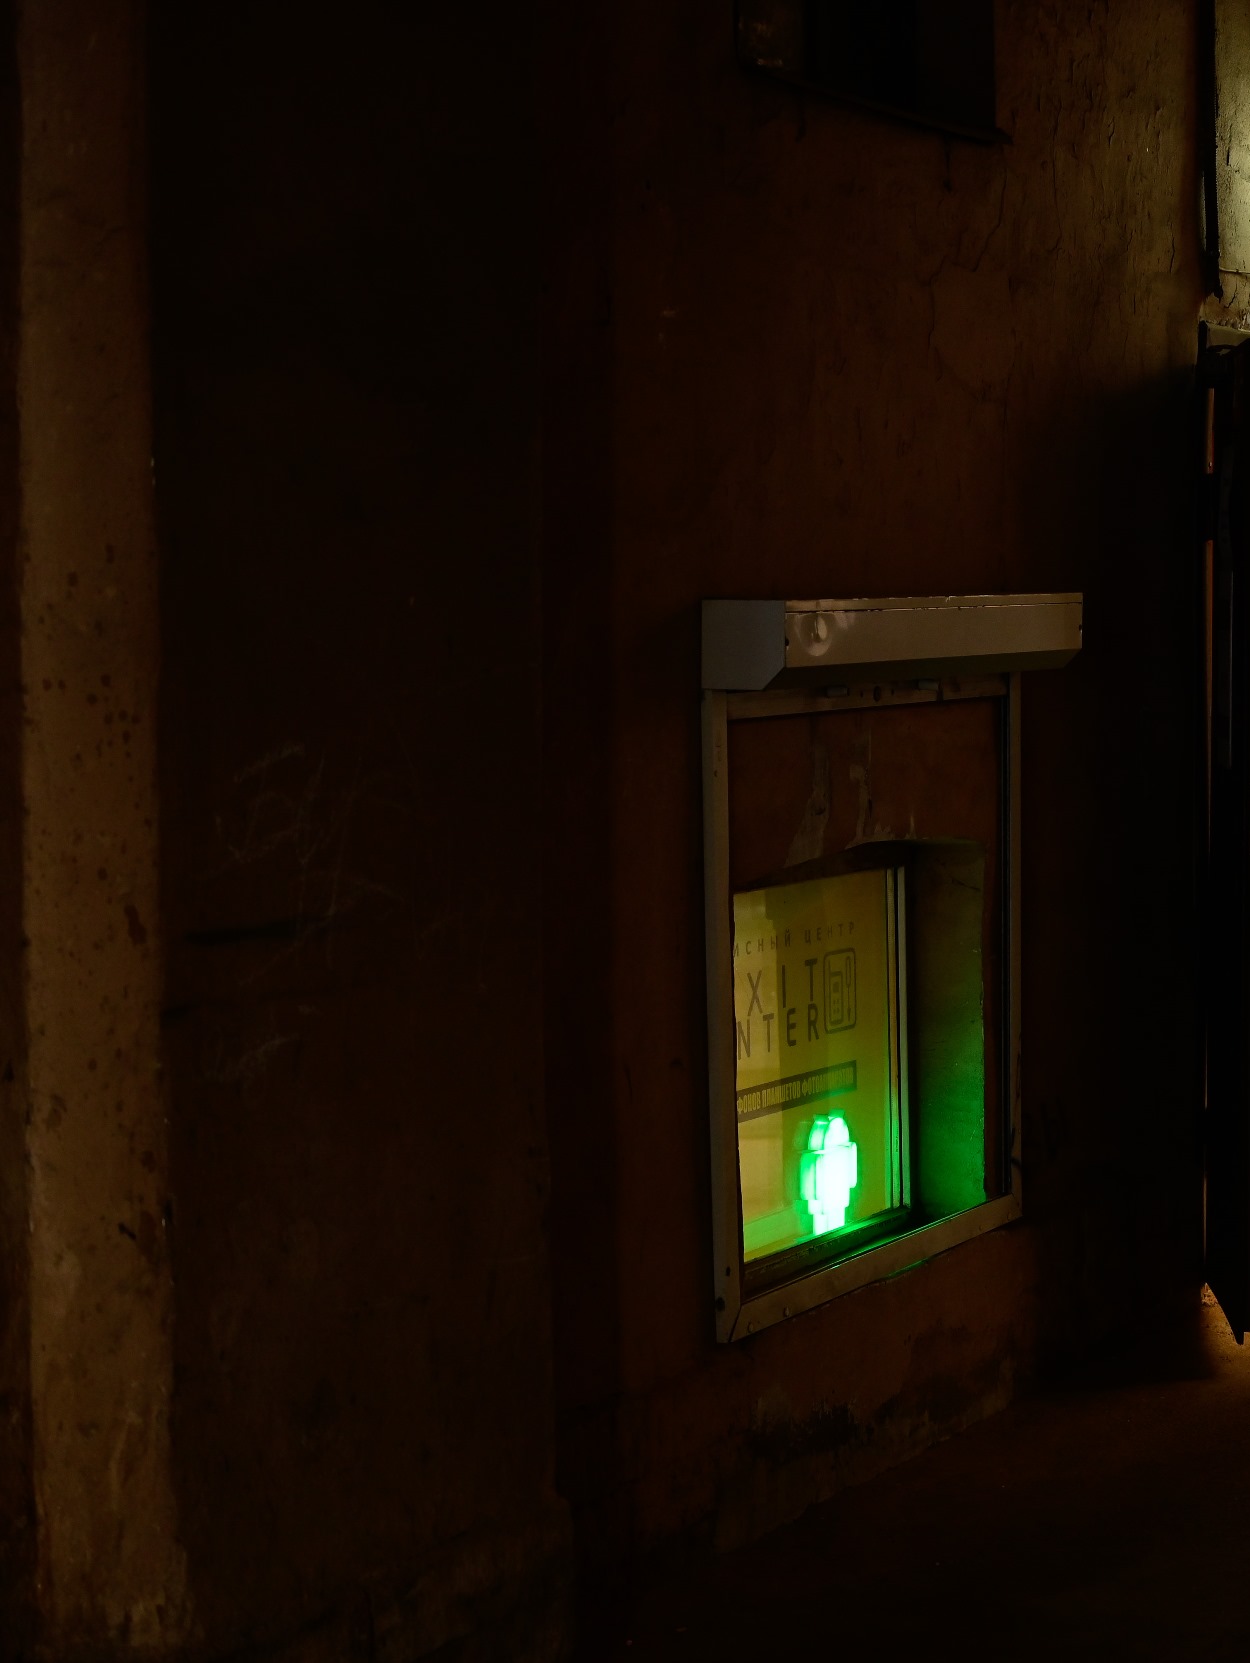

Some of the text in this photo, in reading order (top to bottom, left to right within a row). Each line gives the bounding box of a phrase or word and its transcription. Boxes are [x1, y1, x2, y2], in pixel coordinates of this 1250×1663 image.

[805, 922, 854, 944] ЦЕНТР
[747, 958, 818, 1016] XIT
[736, 1003, 819, 1060] NTER
[761, 1081, 801, 1108] ПЛАНШЕТОВ
